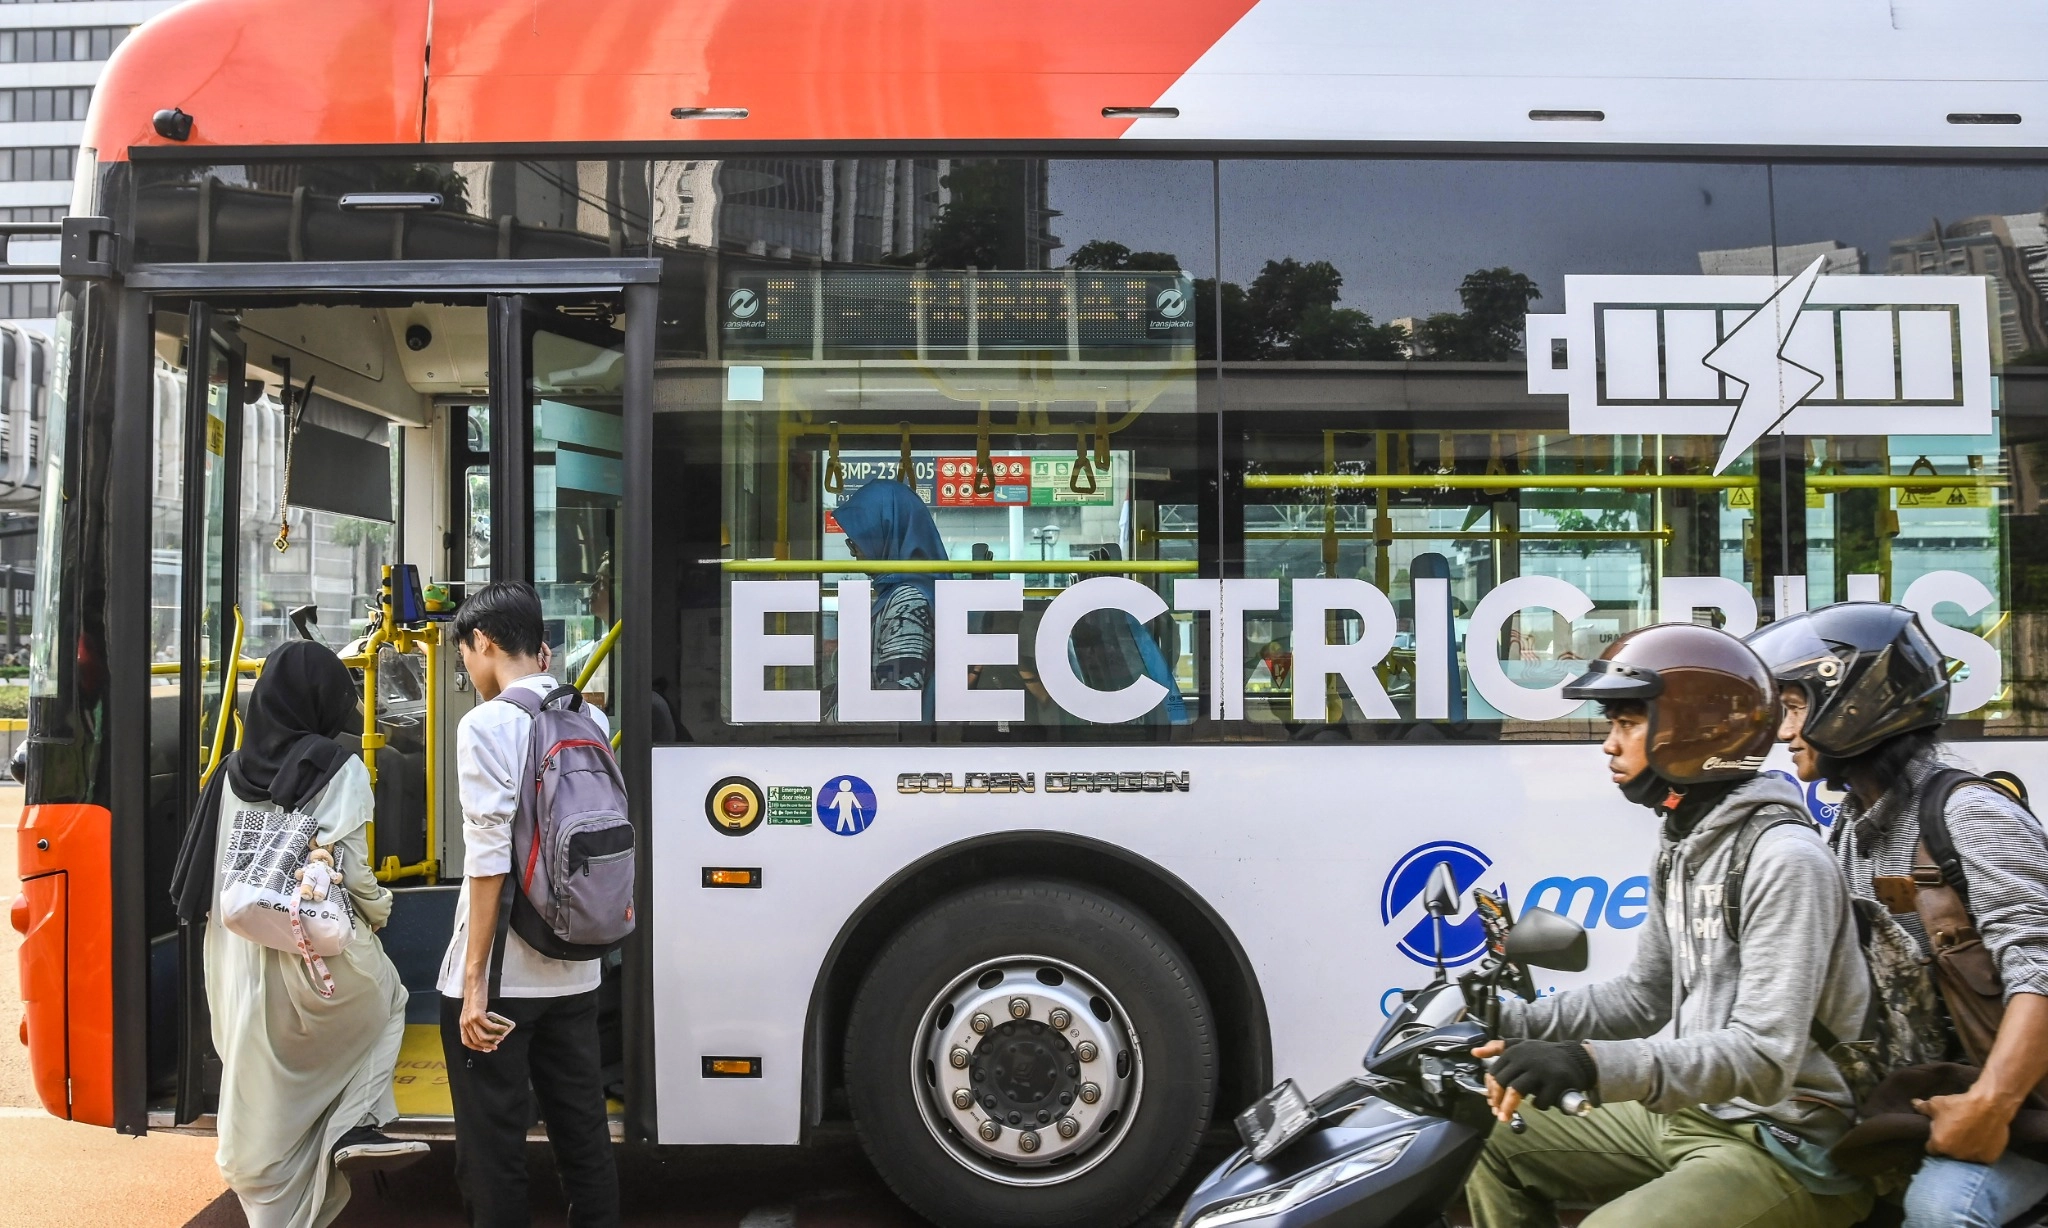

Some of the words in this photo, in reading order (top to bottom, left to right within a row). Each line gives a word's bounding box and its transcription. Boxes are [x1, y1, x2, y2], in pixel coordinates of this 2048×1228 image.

[1149, 320, 1195, 330] transjakarta
[840, 462, 936, 480] BMP-2305
[731, 575, 1596, 724] ELECTRIC
[1661, 570, 2000, 715] BS
[781, 787, 808, 795] Emergency
[896, 772, 1036, 794] GOLDEN
[1044, 770, 1190, 793] DRAGON
[273, 903, 316, 917] GINACO
[1517, 875, 1649, 930] me
